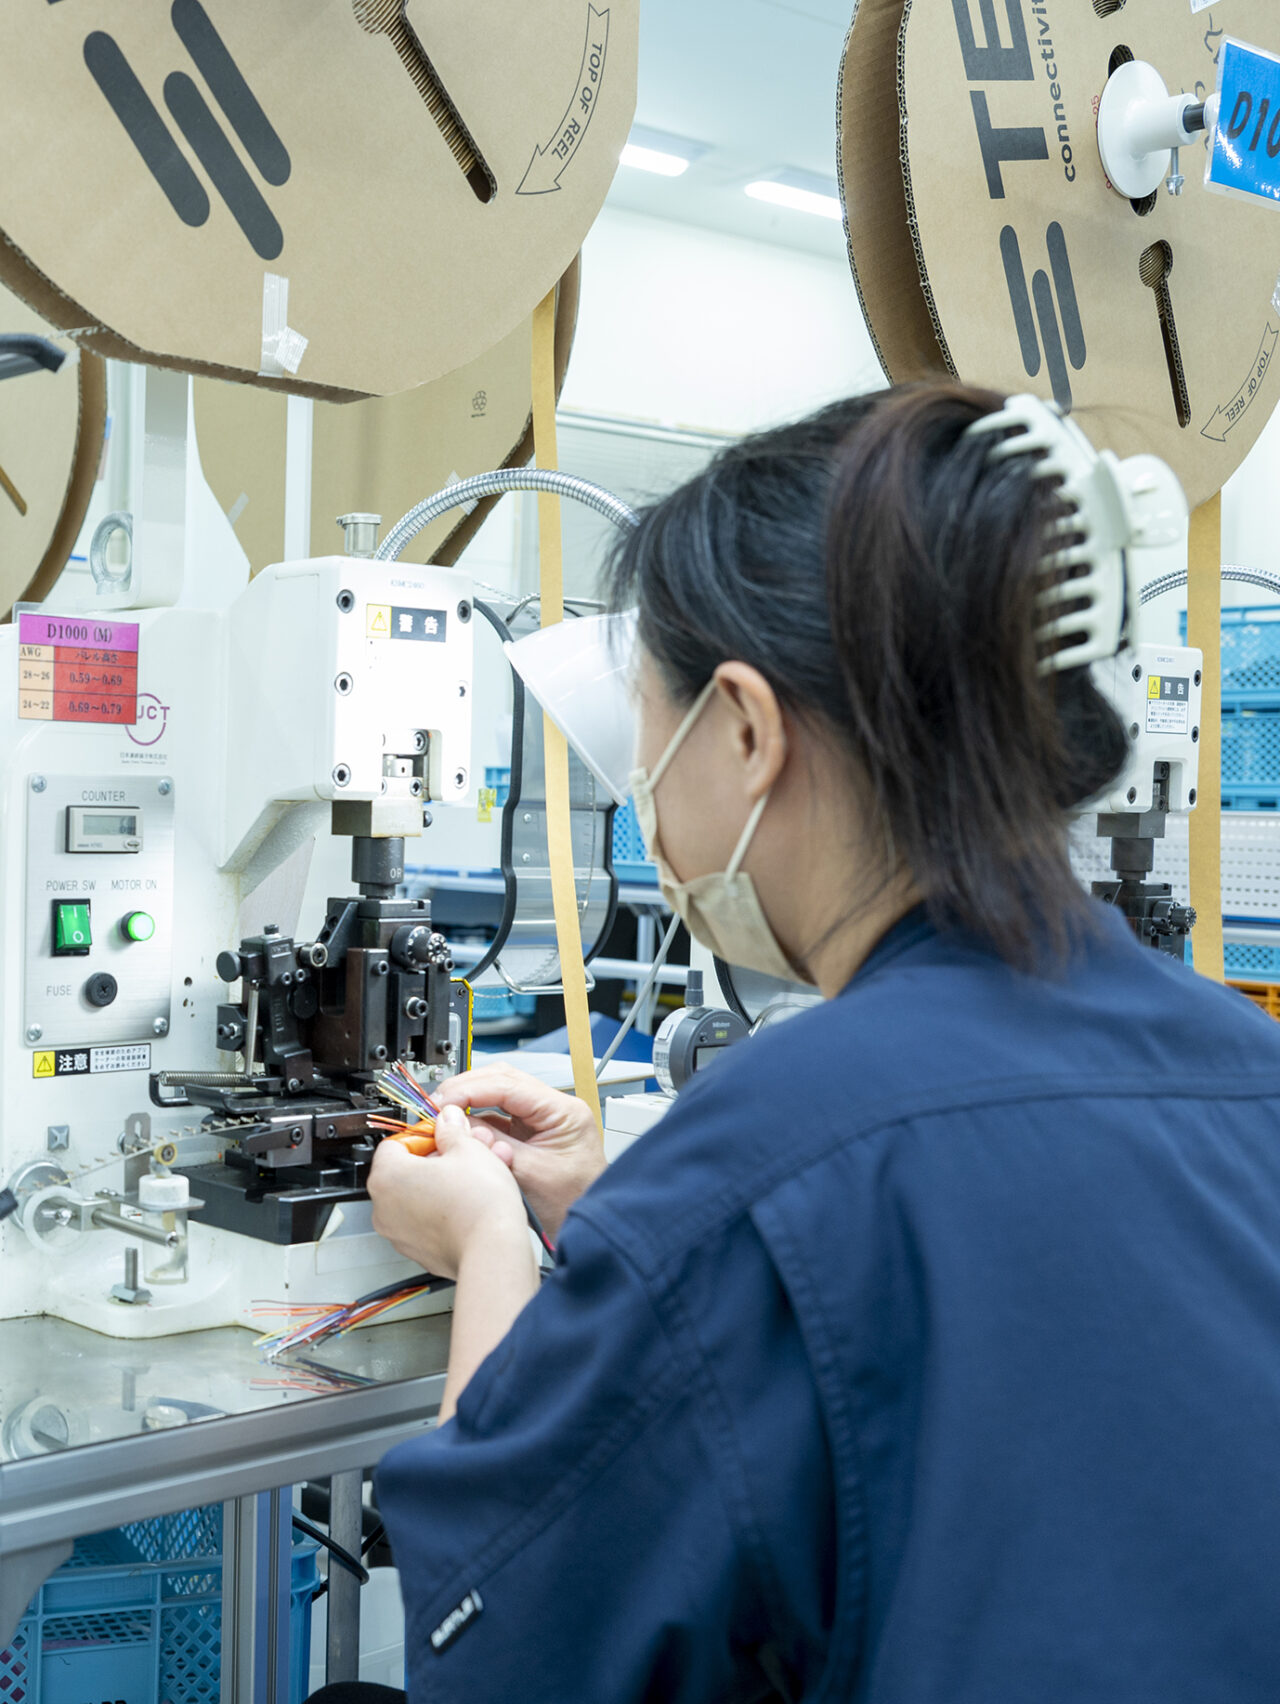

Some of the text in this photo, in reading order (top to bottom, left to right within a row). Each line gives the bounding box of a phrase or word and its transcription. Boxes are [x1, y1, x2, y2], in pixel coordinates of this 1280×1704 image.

[551, 43, 603, 160] TOP OF REEL
[1225, 350, 1270, 422] TOP OF REEL
[47, 623, 113, 644] D1000 (M)
[20, 647, 41, 658] AWG
[137, 705, 170, 721] JCT
[82, 790, 125, 802] COUNTER
[46, 880, 96, 892] POWER SW
[111, 879, 157, 890] MOTOR ON
[46, 985, 72, 996] FUSE
[58, 1053, 88, 1072] 注意
